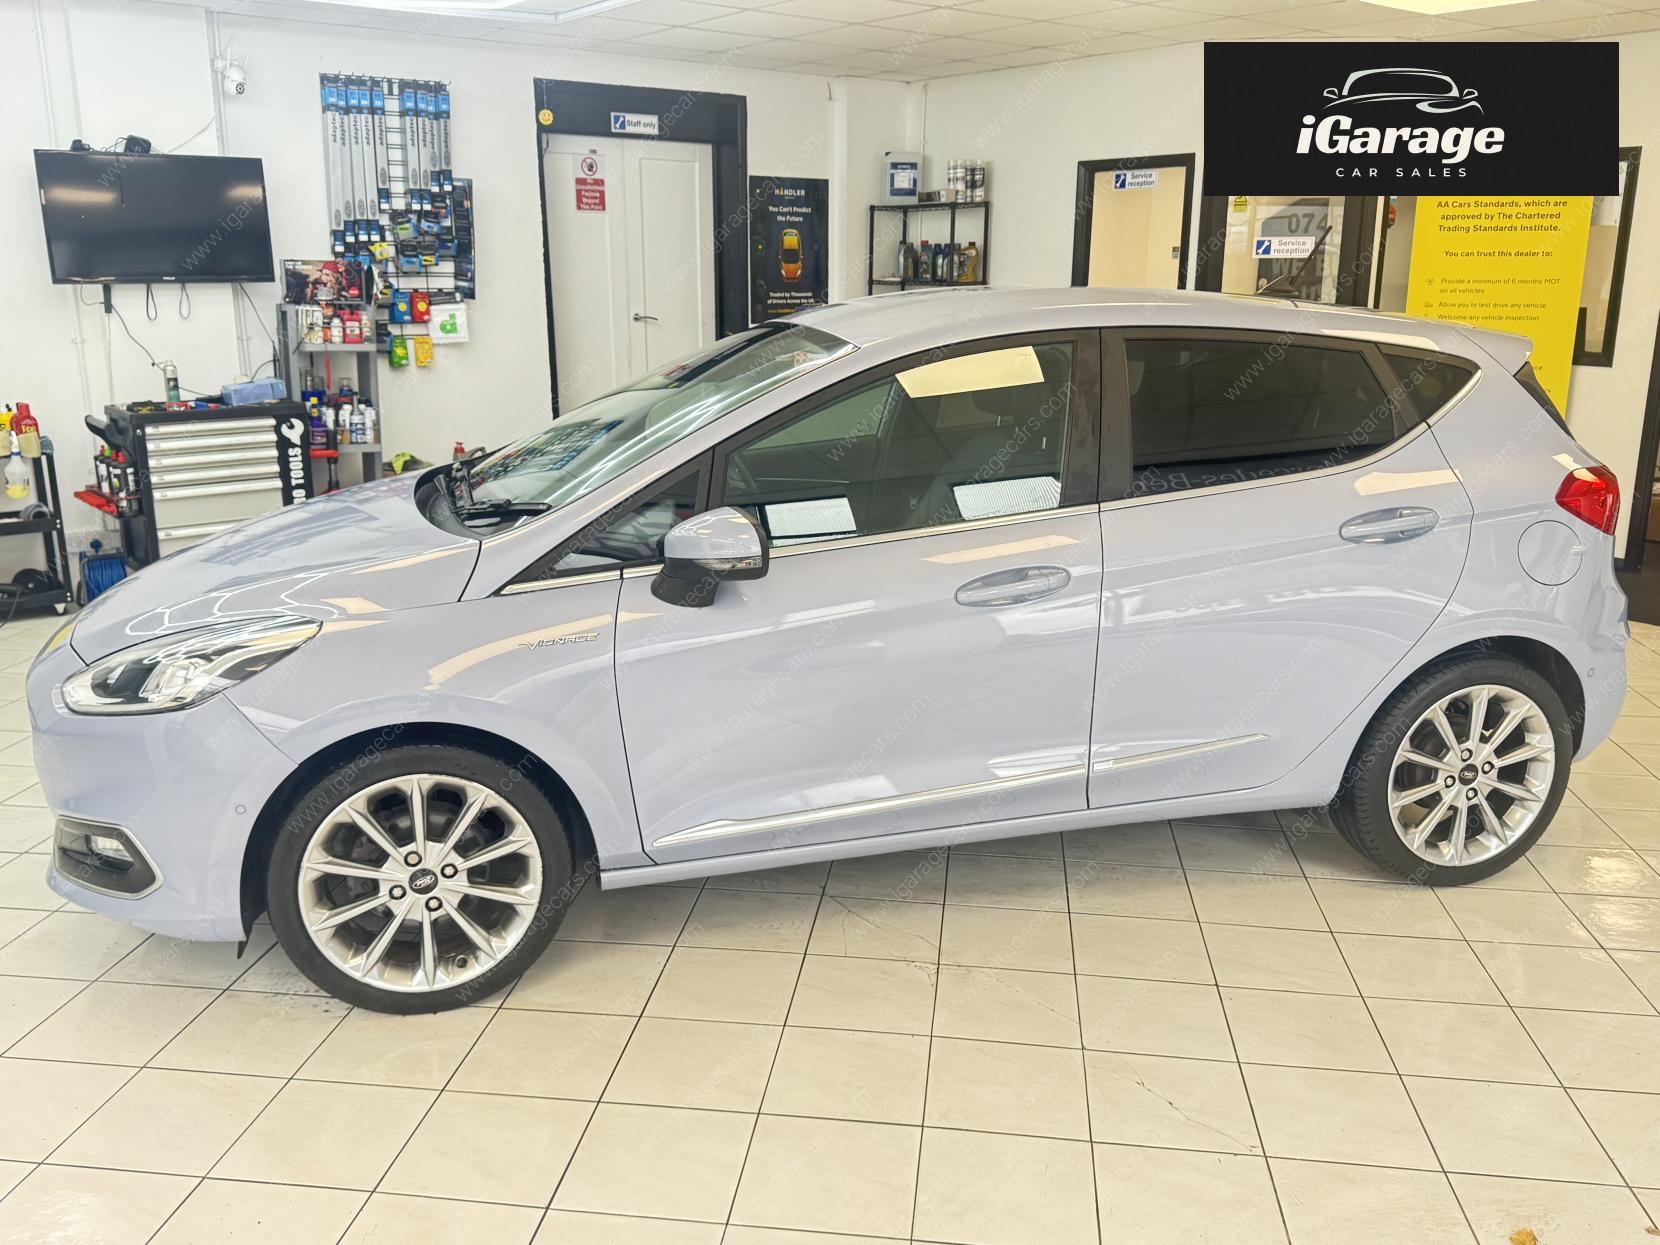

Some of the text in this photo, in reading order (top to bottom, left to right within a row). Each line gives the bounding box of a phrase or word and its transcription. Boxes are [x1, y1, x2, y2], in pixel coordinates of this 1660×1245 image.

[1127, 180, 1155, 188] reception
[1451, 200, 1471, 208] Cars
[1473, 200, 1522, 209] Standards,
[1524, 199, 1551, 207] which
[1440, 212, 1561, 221] approved by The Chartered
[1438, 224, 1561, 234] Trading Standards Institute.
[1273, 247, 1310, 255] reception
[1505, 314, 1540, 322] inspection
[287, 447, 307, 505] RO TOOLS
